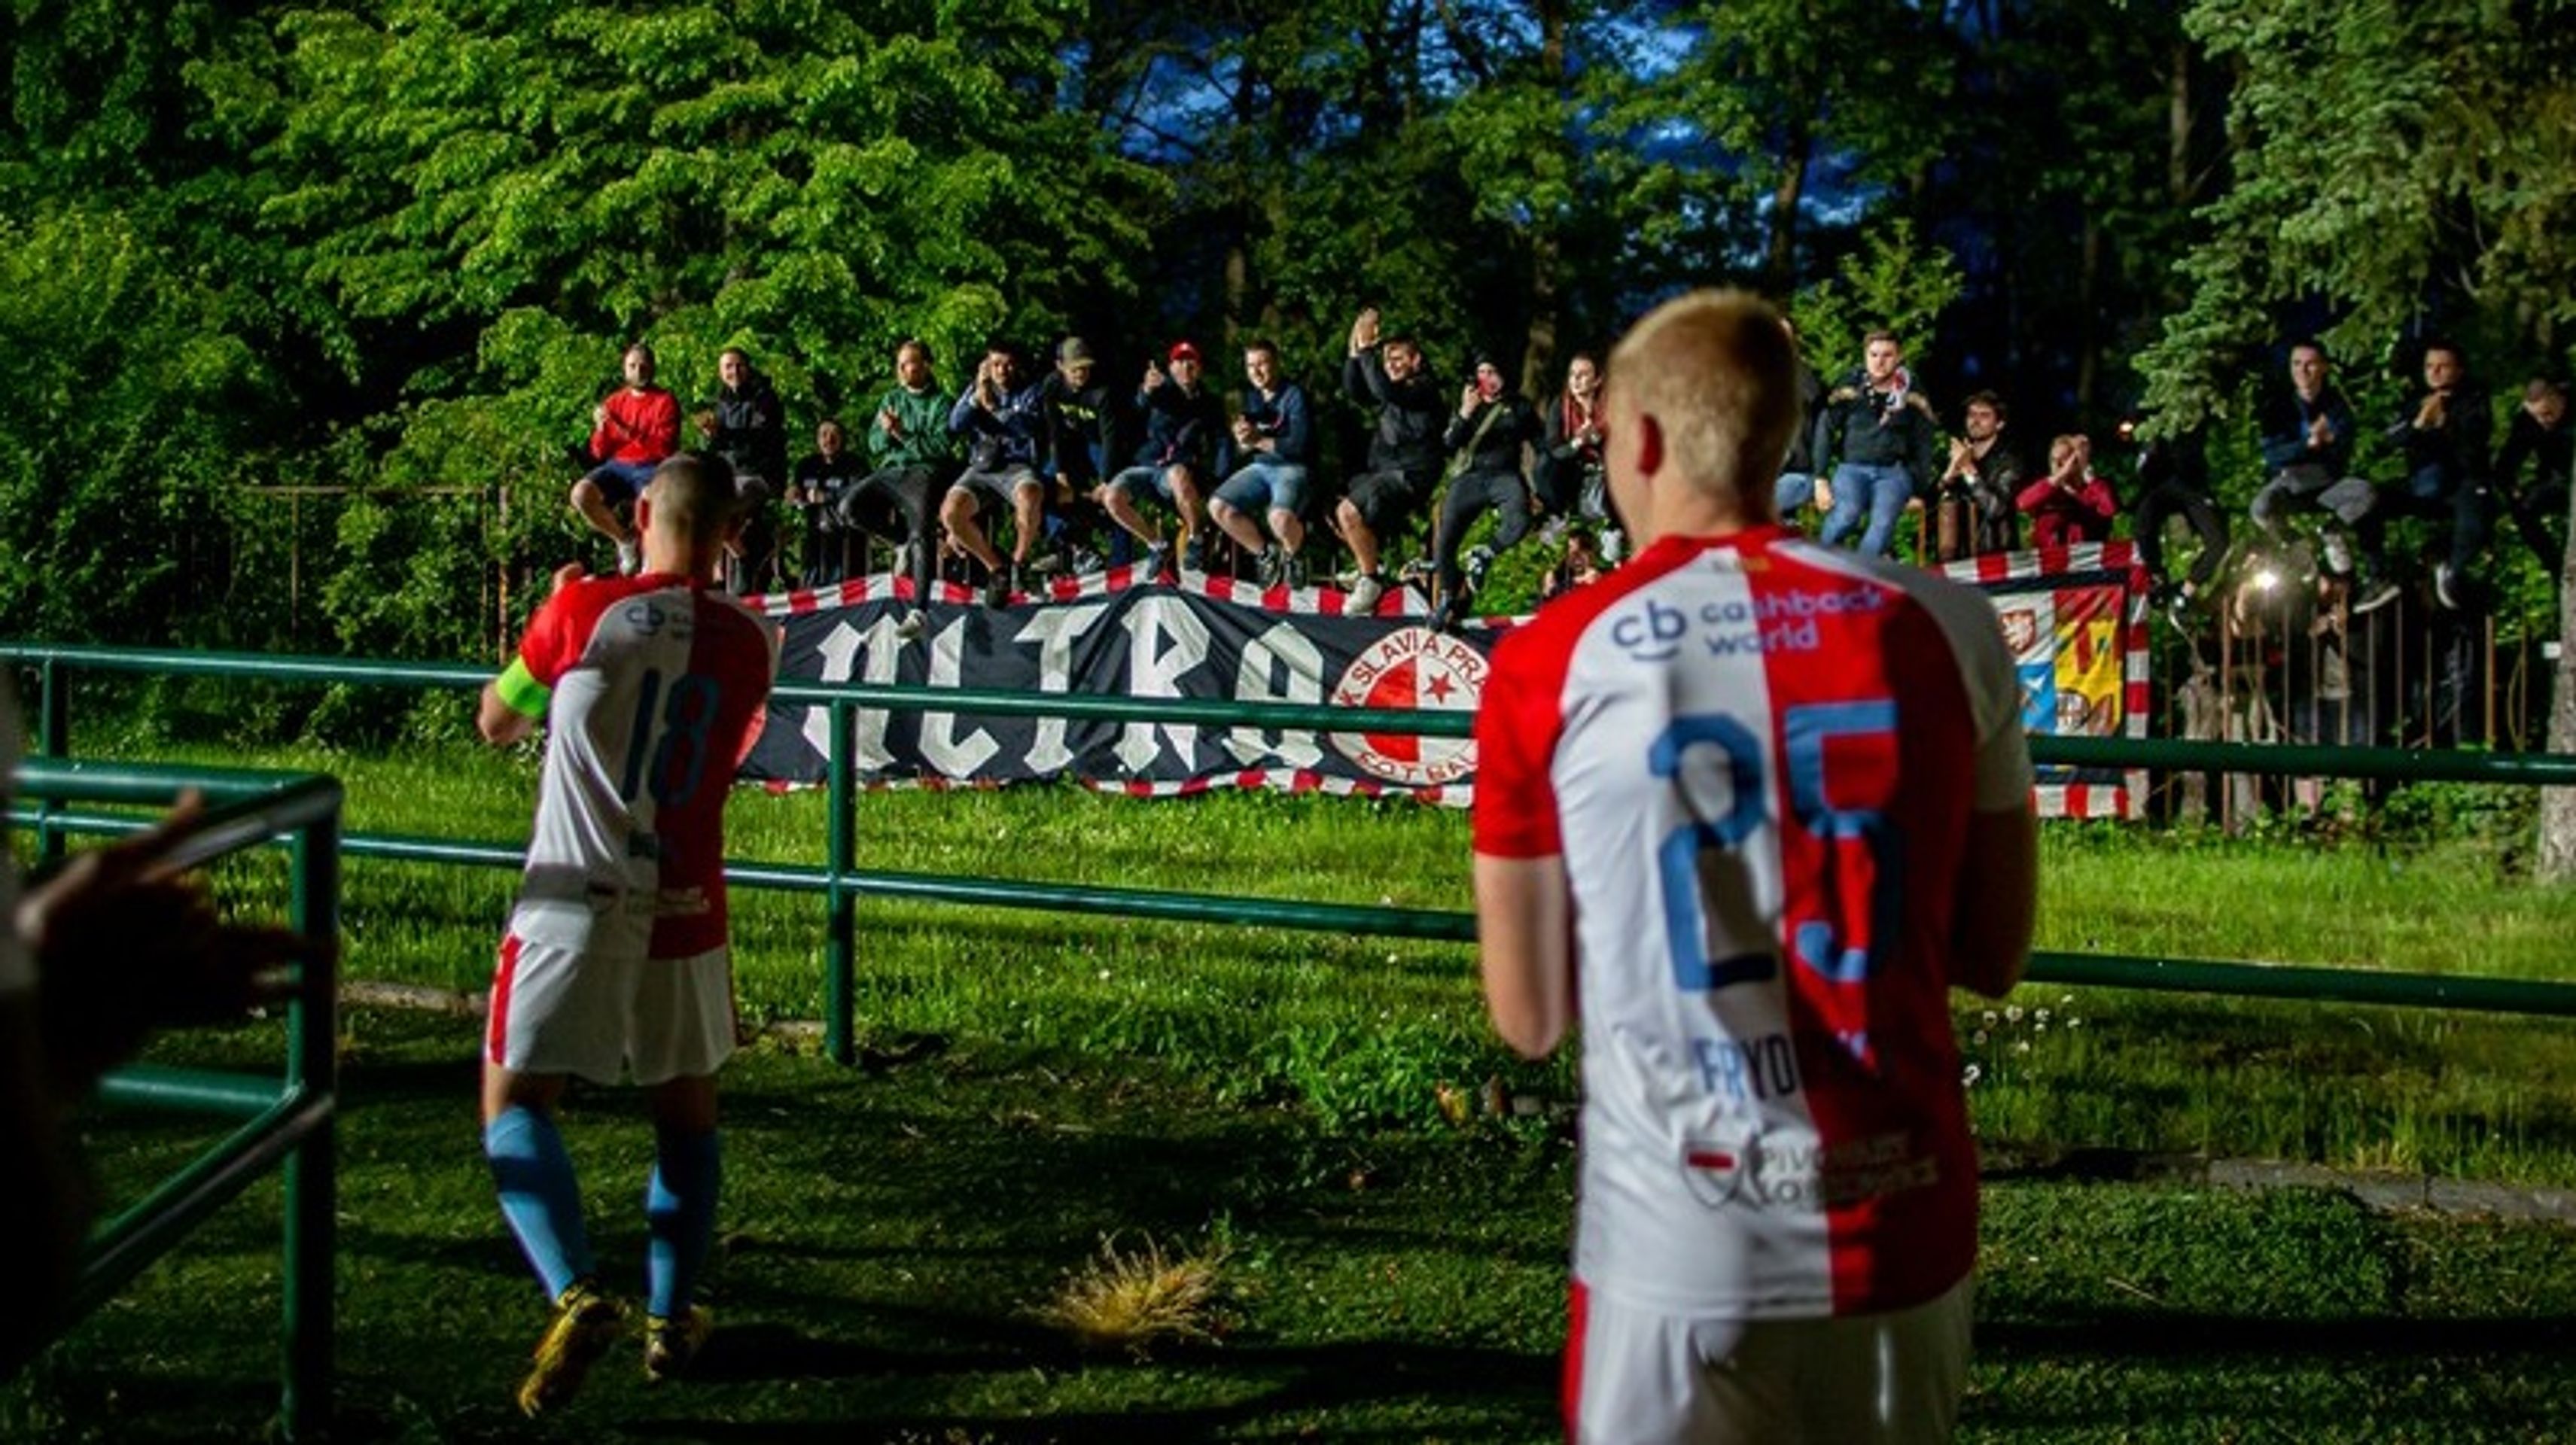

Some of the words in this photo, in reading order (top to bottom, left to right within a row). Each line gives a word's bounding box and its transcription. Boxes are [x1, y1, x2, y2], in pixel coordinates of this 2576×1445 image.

[1612, 602, 1686, 649] cb
[1701, 583, 1881, 623] cashback
[1351, 629, 1439, 685] SLAVIA
[1705, 618, 1820, 655] world
[623, 671, 720, 805] 18
[1649, 698, 1903, 992] 25
